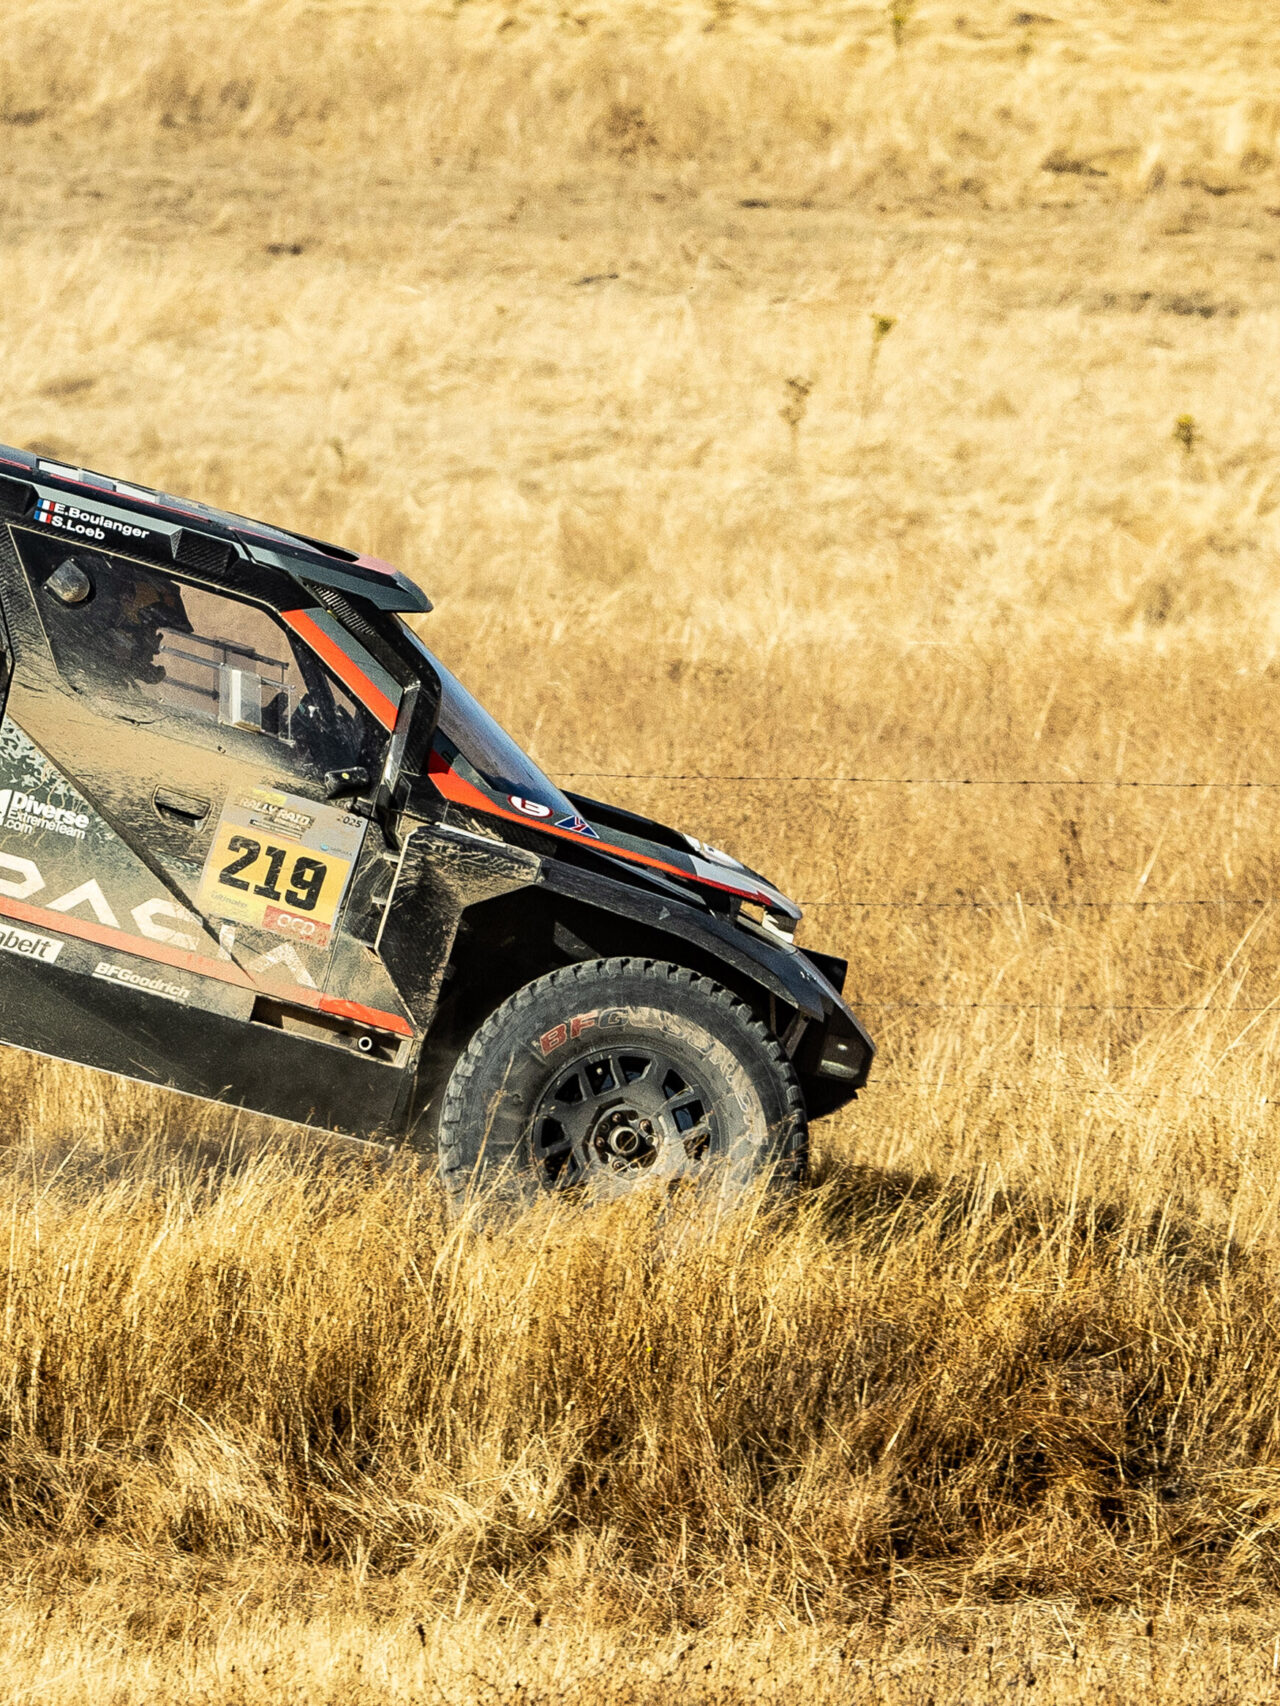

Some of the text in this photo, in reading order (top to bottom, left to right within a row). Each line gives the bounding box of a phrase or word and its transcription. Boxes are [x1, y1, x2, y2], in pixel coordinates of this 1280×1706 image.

[51, 515, 106, 540] S.Loeb
[53, 503, 150, 539] E.Boulanger
[7, 807, 86, 840] ExtremeTeam
[12, 790, 90, 829] Diverse
[239, 797, 311, 826] RALLY RAID
[4, 819, 33, 835] .com
[218, 835, 328, 912] 219
[93, 961, 191, 999] BFGoodrich
